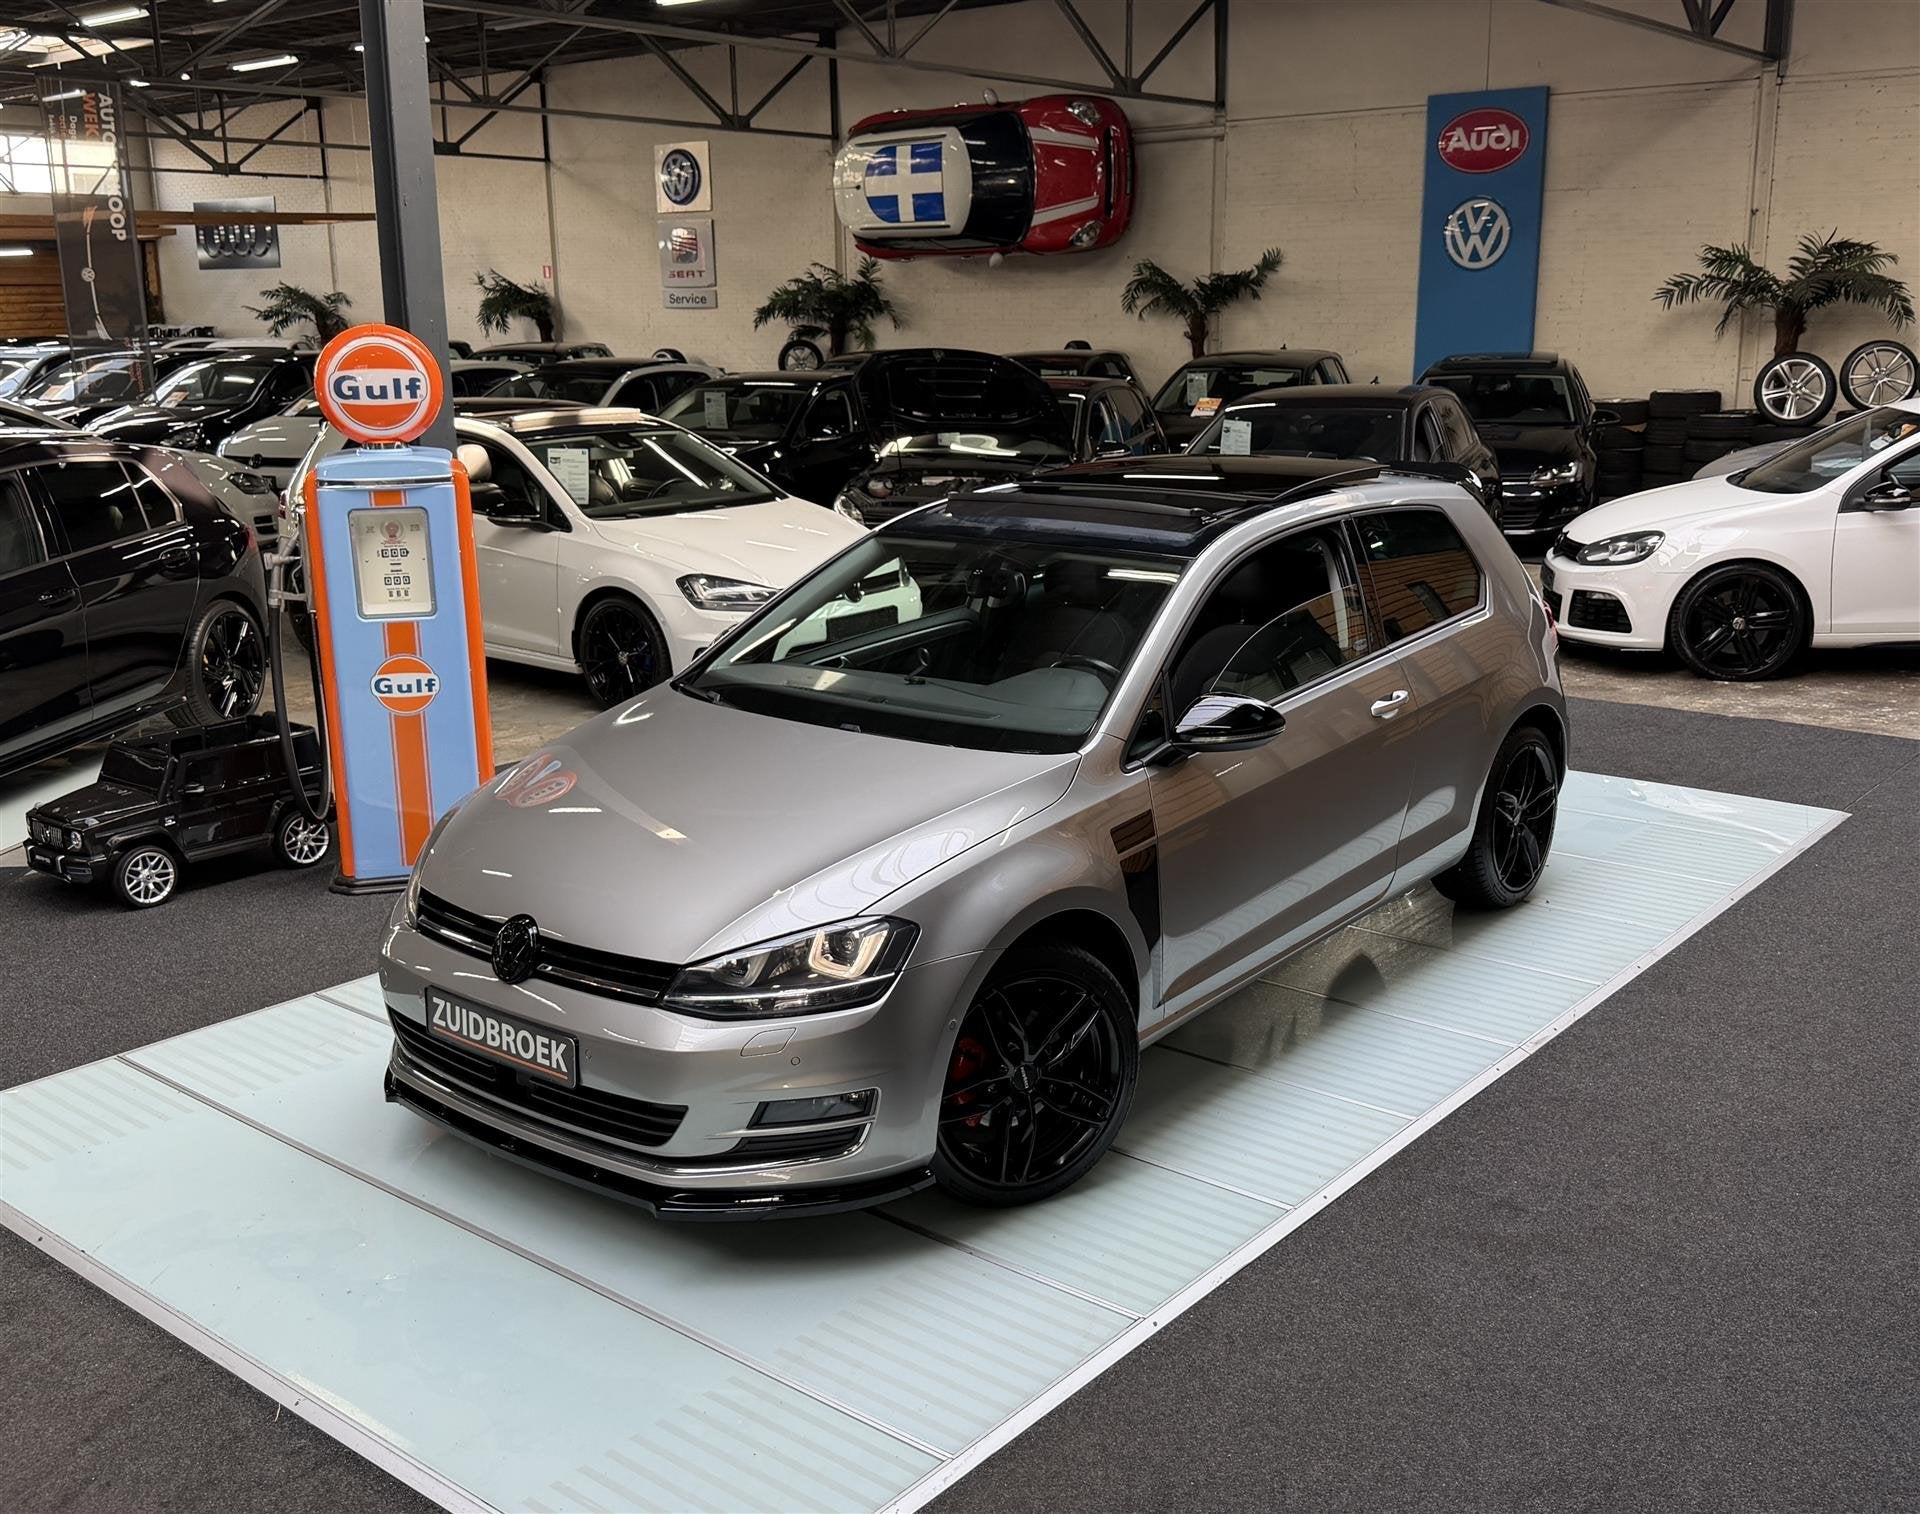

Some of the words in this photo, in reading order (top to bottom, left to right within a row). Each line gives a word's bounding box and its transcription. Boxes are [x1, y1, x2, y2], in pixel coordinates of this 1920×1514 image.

[1446, 124, 1520, 153] Audi
[668, 269, 706, 279] SEAT
[669, 293, 707, 305] Service
[333, 375, 421, 400] Gulf
[374, 677, 436, 694] Gulf
[432, 996, 568, 1073] ZUIDBROEK
